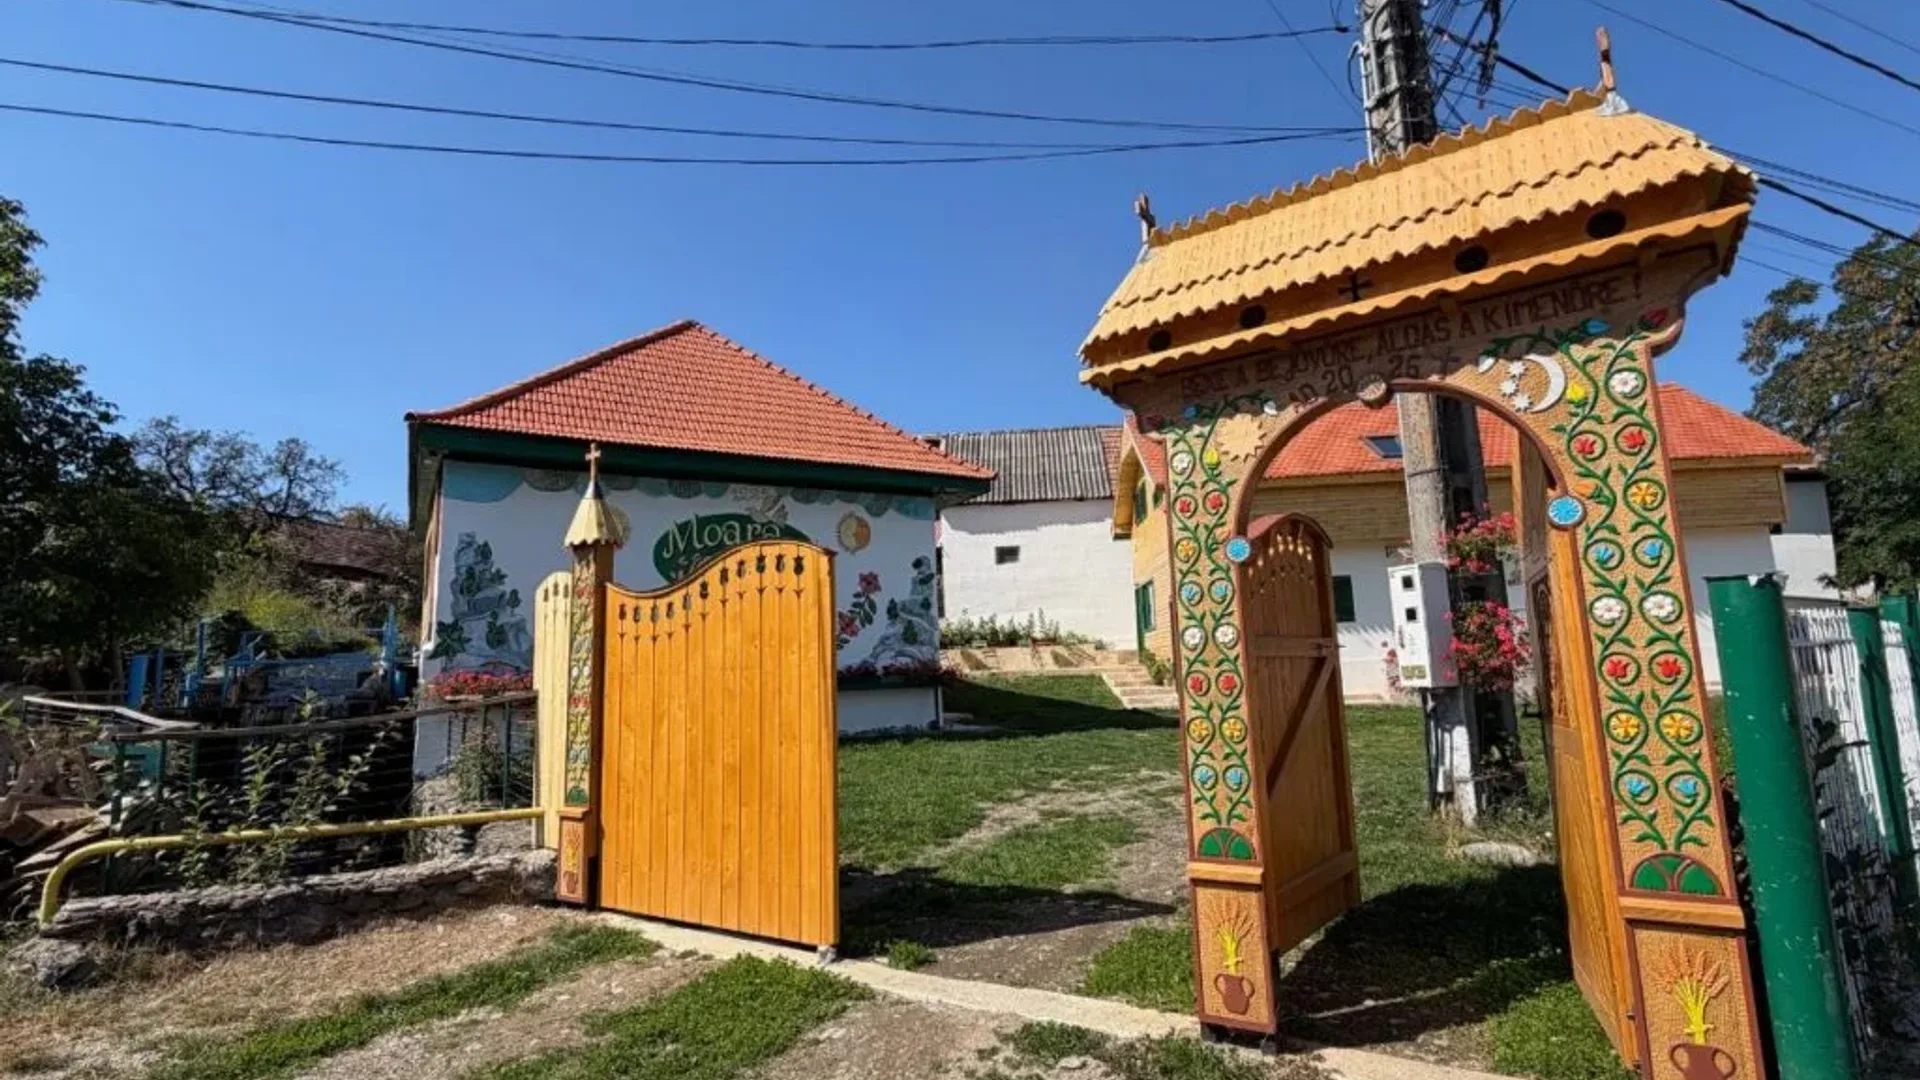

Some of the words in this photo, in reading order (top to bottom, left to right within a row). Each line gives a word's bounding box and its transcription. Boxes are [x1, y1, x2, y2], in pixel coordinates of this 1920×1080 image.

[1459, 310, 1477, 338] A
[1321, 364, 1354, 394] 20
[661, 512, 781, 559] Moara
